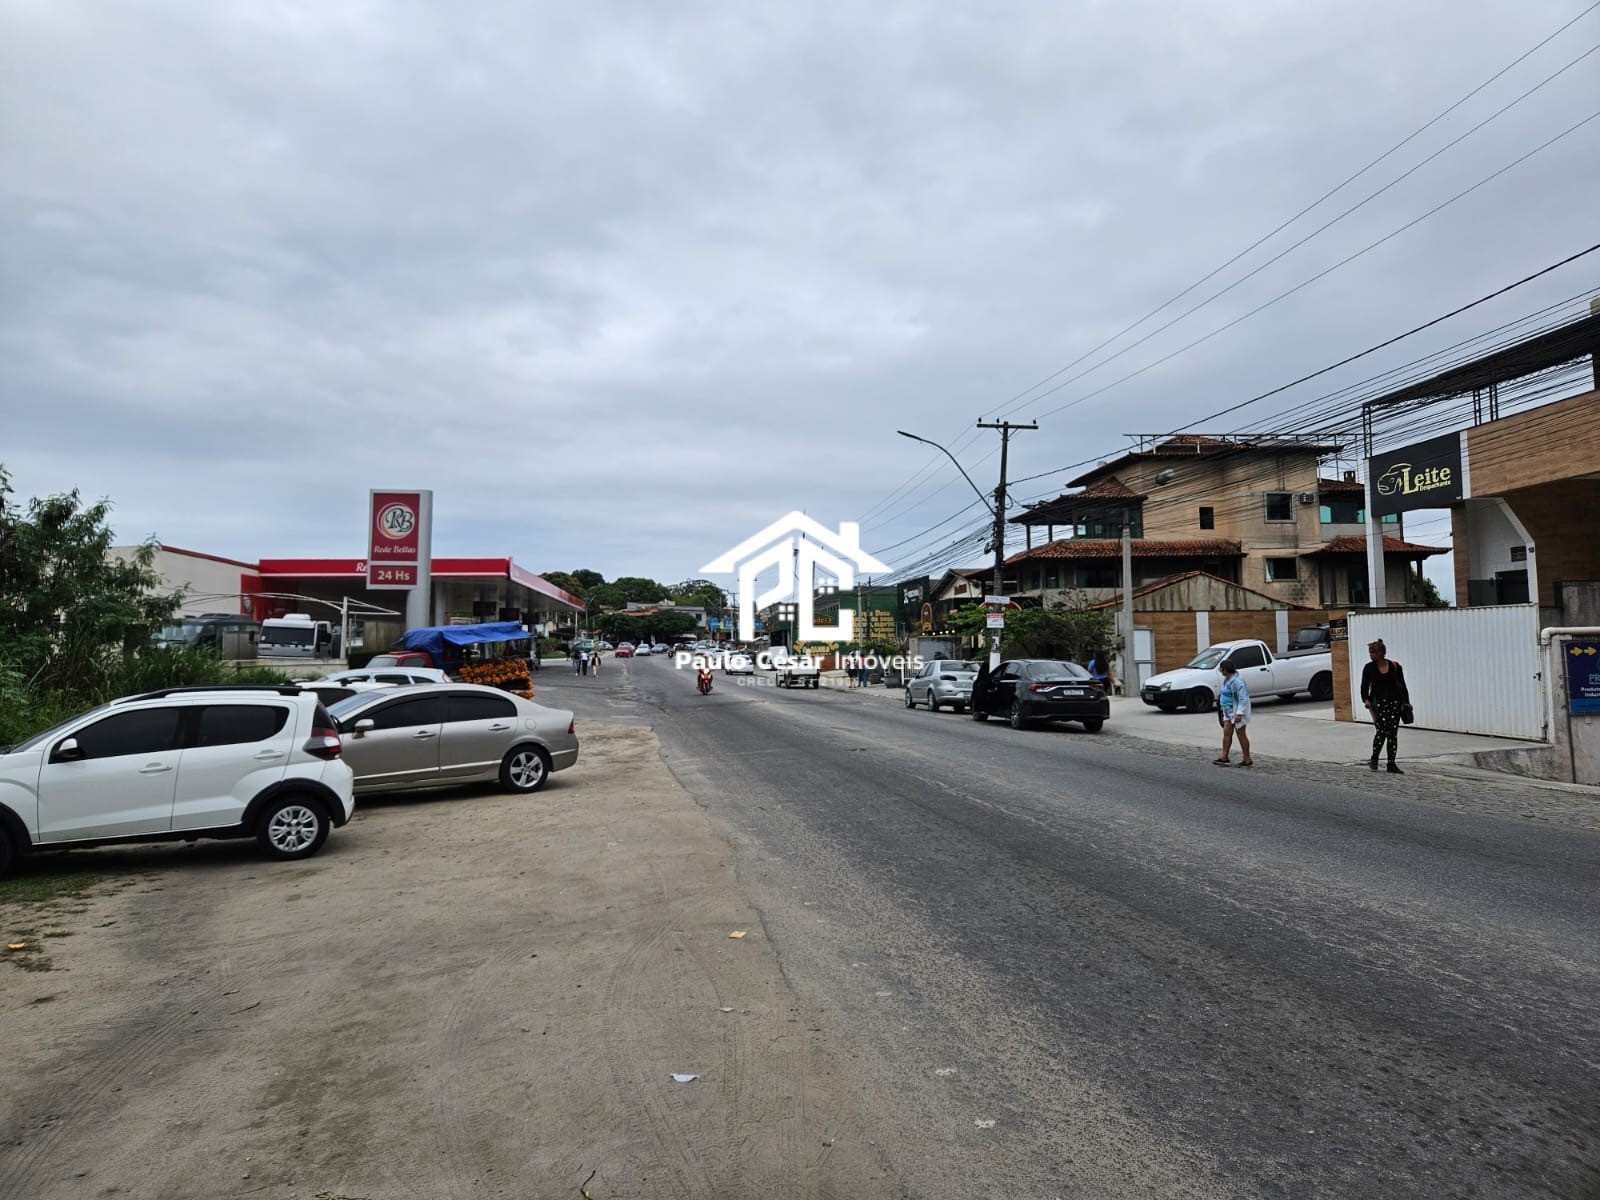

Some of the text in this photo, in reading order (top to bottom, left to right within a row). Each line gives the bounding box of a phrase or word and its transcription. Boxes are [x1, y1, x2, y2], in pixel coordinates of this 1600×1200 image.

[1401, 467, 1451, 495] Leite
[378, 571, 410, 580] 24 Hs
